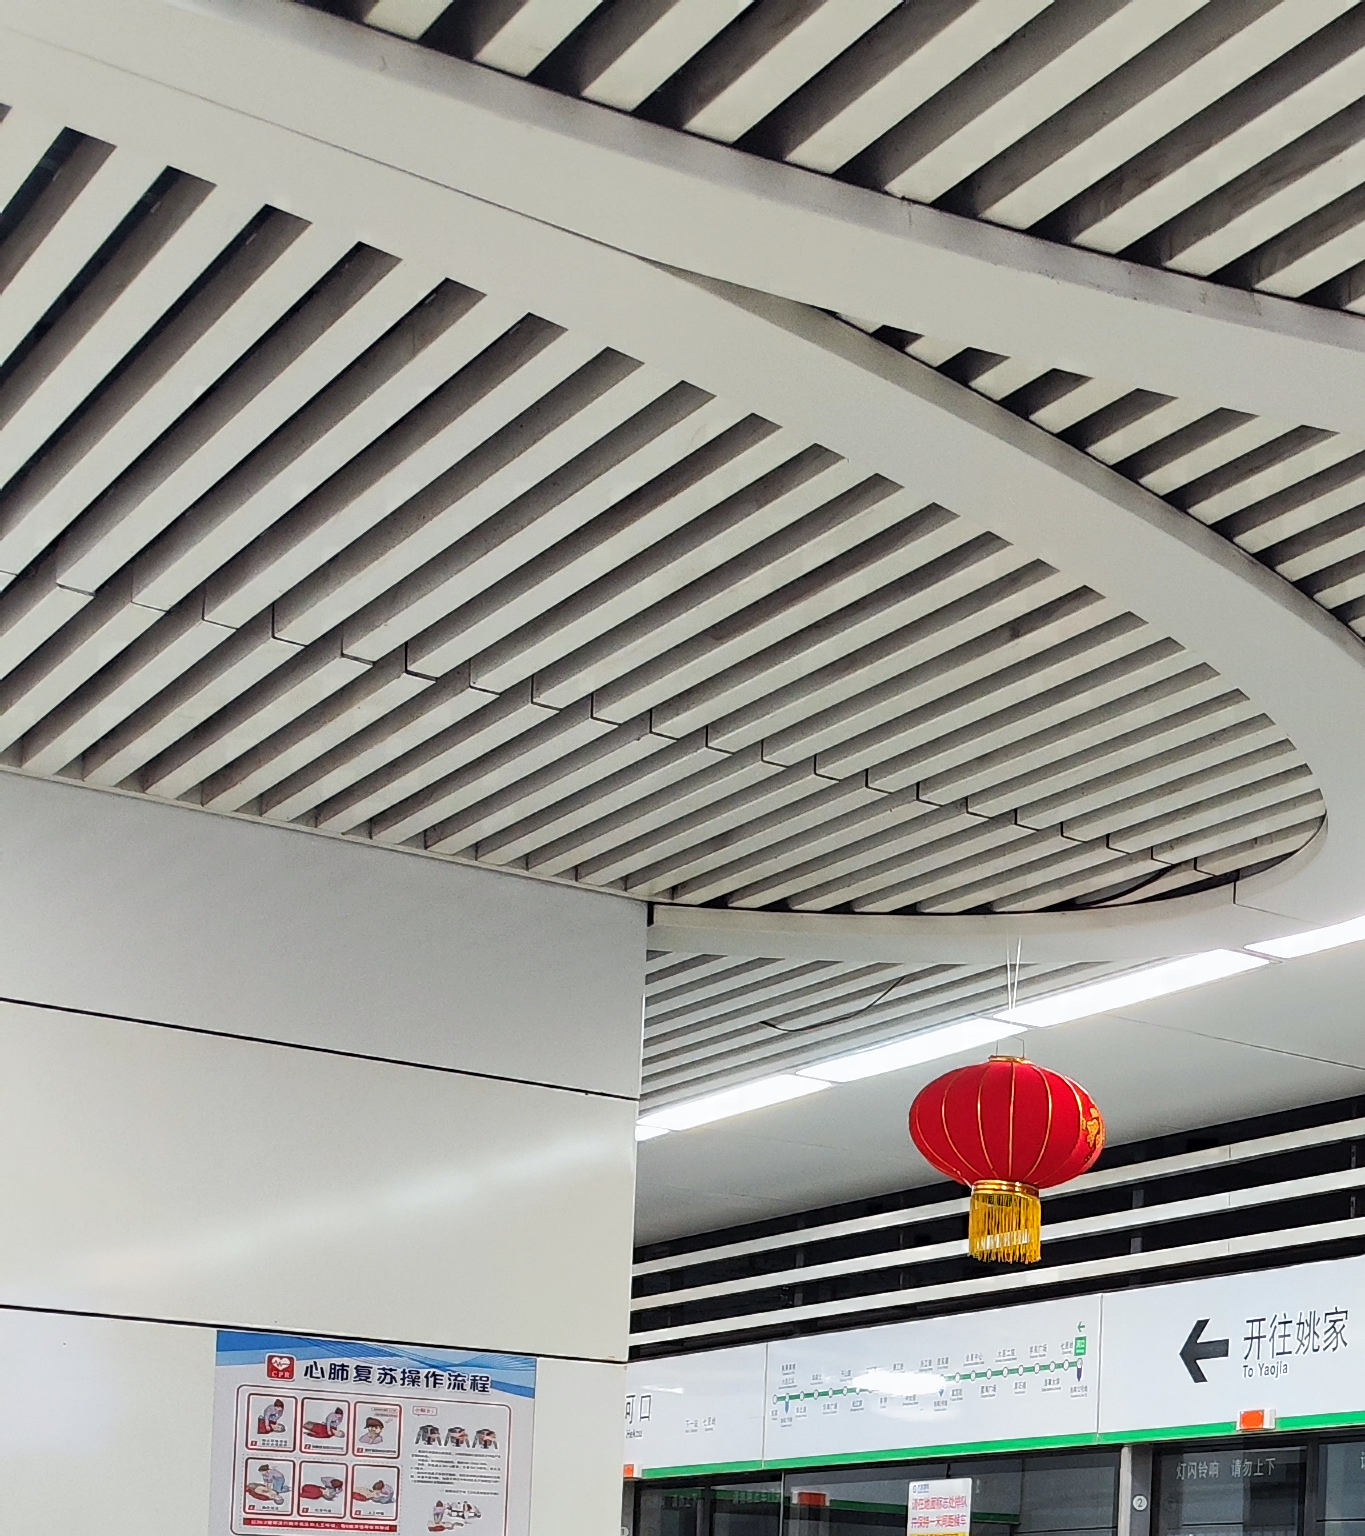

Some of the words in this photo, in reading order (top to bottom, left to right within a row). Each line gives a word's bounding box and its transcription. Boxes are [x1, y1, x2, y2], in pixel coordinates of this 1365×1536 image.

[1243, 1306, 1348, 1361] 开往姚家
[303, 1360, 491, 1393] 心肺复苏操作流程
[1243, 1365, 1254, 1378] To
[1258, 1362, 1288, 1379] Yaojia
[1176, 1461, 1219, 1480] 灯闪铃响
[1231, 1457, 1276, 1477] 请勿上下
